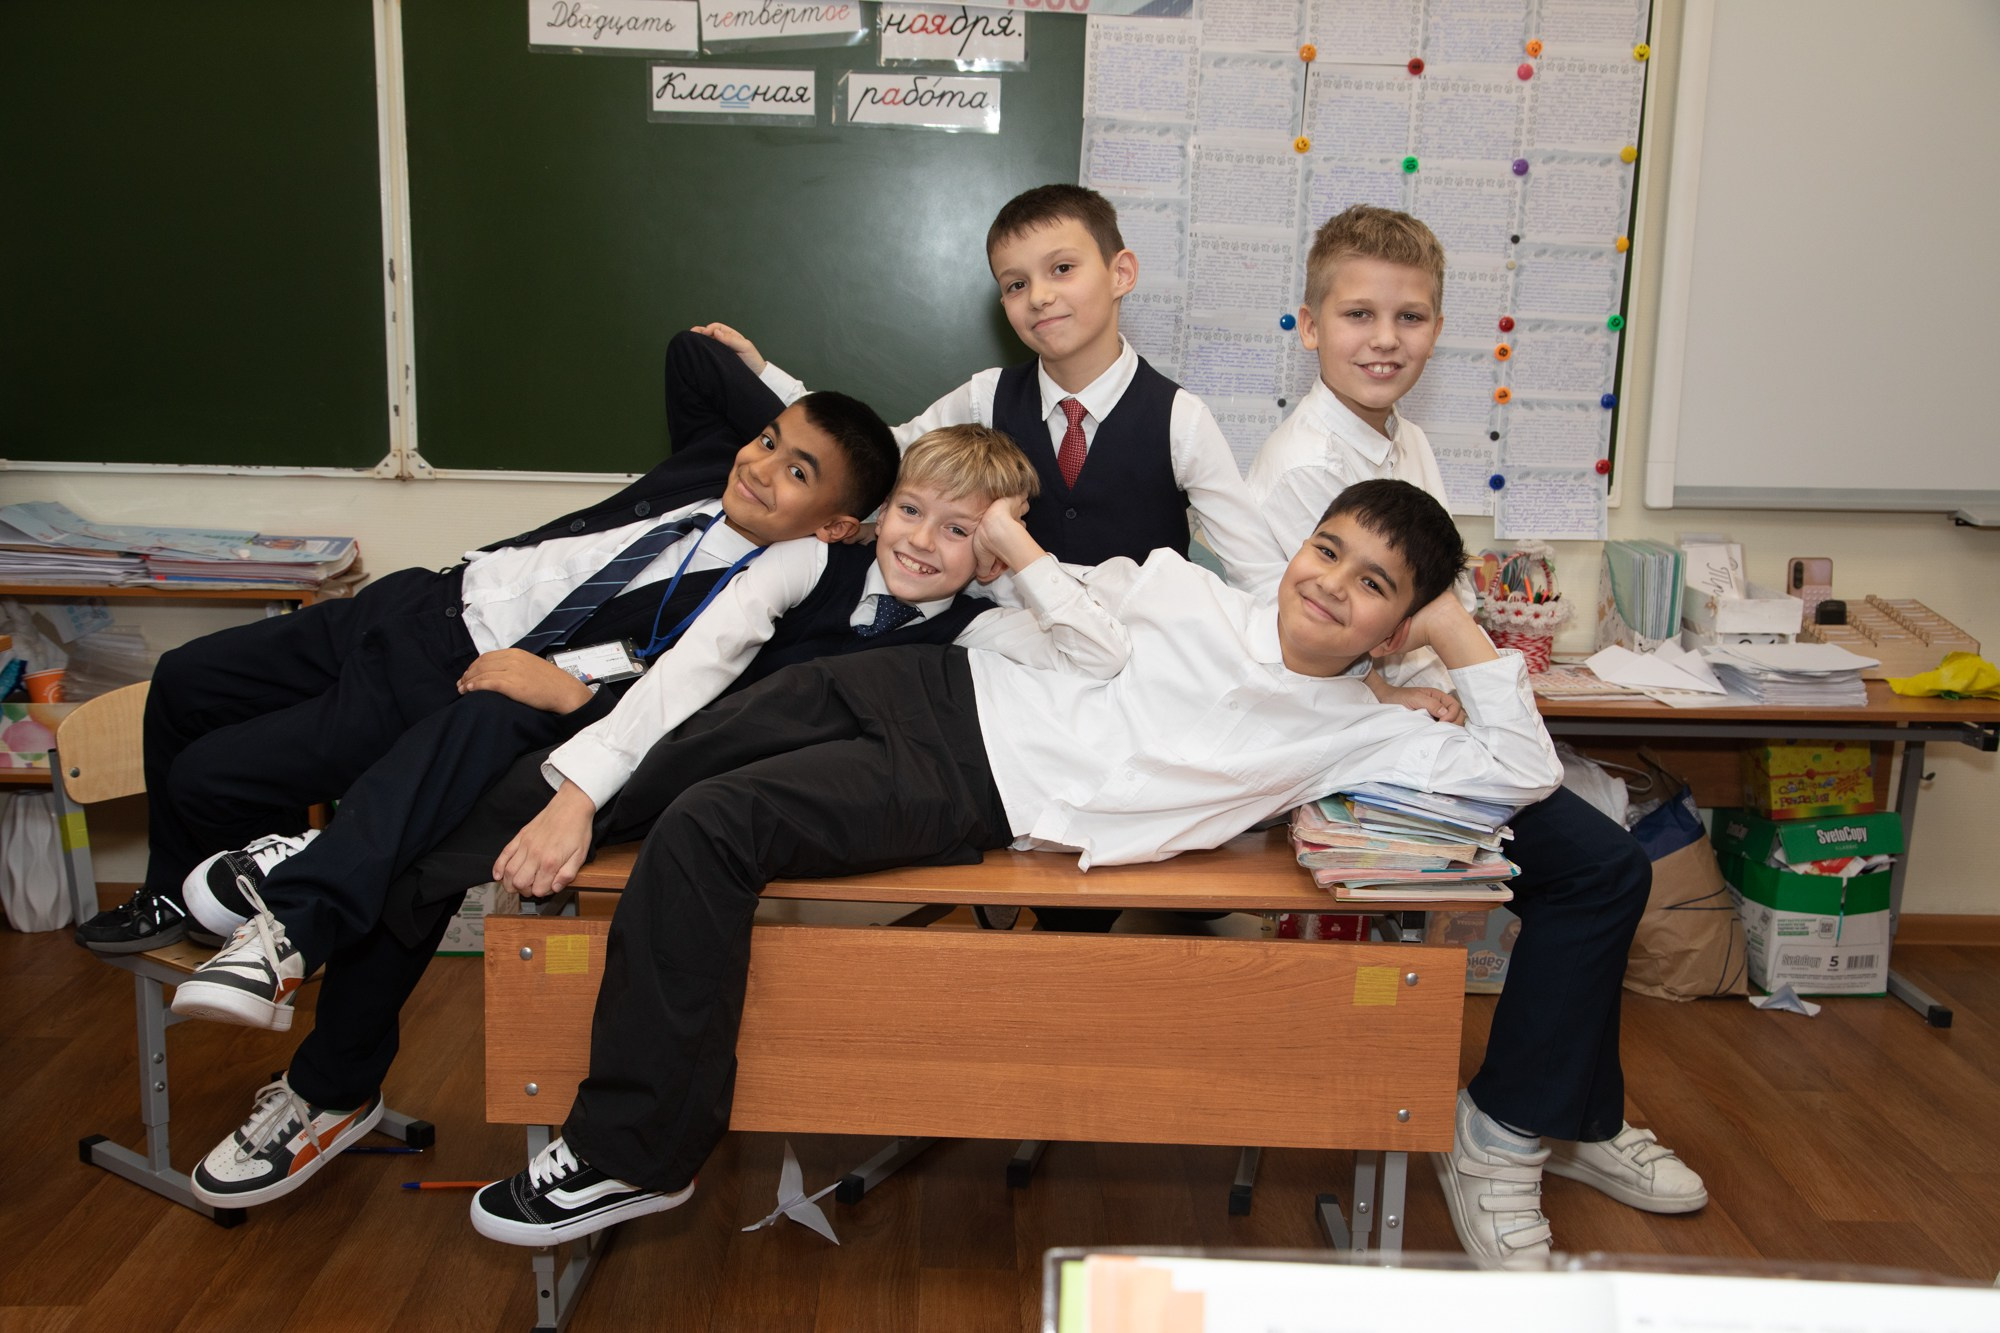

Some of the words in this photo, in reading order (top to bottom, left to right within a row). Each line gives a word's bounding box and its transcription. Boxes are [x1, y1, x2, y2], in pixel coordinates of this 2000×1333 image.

[547, 1, 676, 40] Двадцать
[706, 0, 850, 33] четвёртое
[655, 72, 811, 104] Классная
[1816, 826, 1868, 844] SvetoCopy
[1829, 956, 1839, 967] 5
